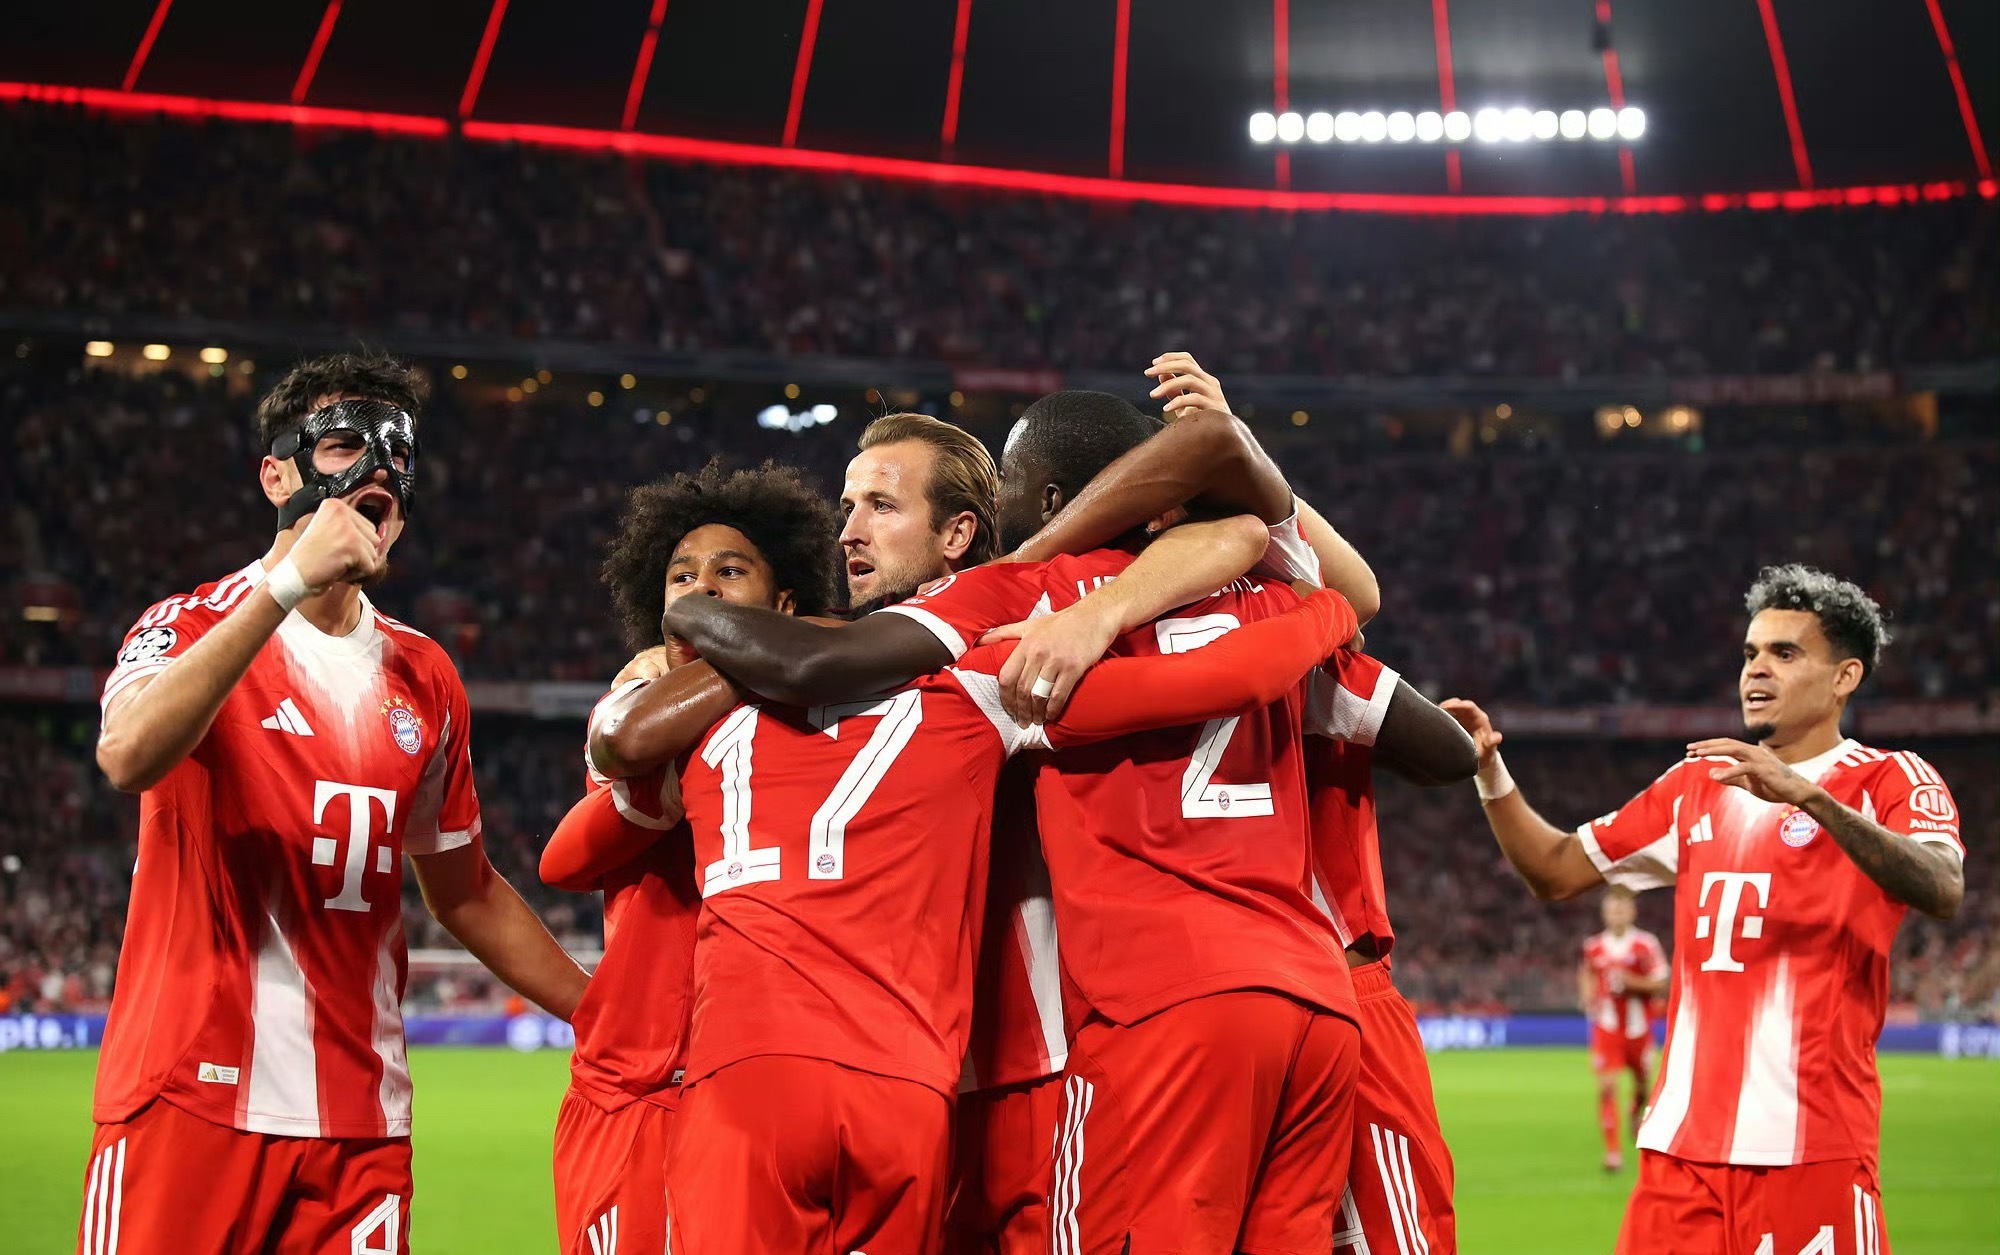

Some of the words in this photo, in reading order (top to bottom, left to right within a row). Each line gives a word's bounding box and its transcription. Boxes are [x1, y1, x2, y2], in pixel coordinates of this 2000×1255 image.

[312, 780, 398, 912] T
[701, 688, 923, 899] 17
[1695, 872, 1772, 972] T
